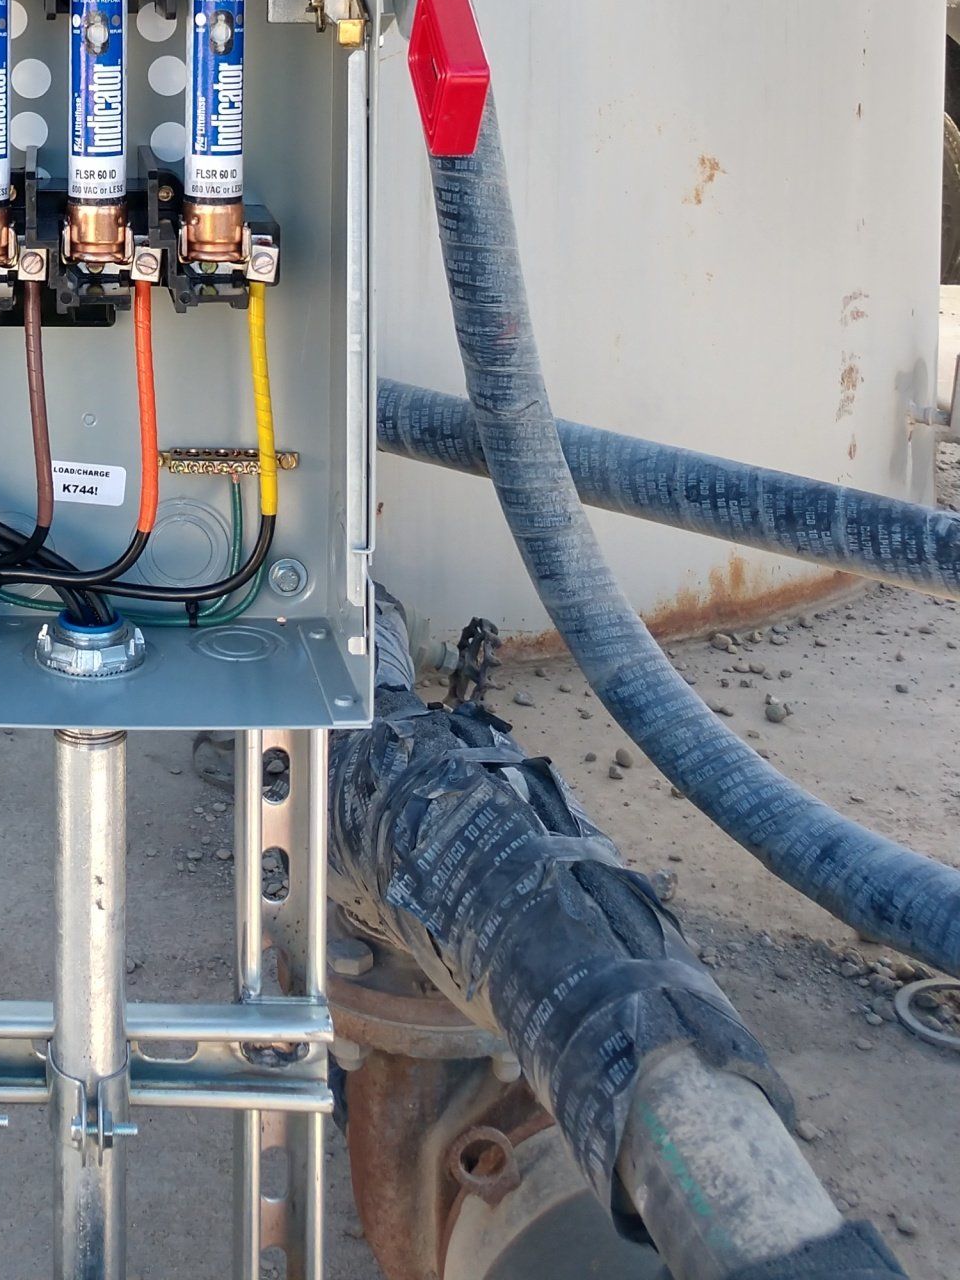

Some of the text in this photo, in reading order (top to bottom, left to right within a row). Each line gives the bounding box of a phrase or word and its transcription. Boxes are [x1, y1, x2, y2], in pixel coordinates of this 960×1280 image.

[75, 97, 83, 138] Littelfuse
[87, 63, 121, 153] Indicator
[197, 96, 206, 134] Littelfuse
[211, 62, 242, 152] Indicator
[75, 169, 116, 180] FLSR 60 ID
[84, 186, 98, 194] VAC
[109, 184, 123, 193] LESS
[196, 169, 237, 179] FLSR 60 ID
[206, 185, 220, 194] VAC
[223, 186, 230, 194] or
[53, 467, 110, 478] LOAD/CHARGE
[434, 806, 497, 887] CALPICO 10 MIL
[478, 913, 501, 950] 10 MIL
[524, 997, 554, 1049] CALPICO
[553, 982, 569, 1000] 10
[597, 1057, 632, 1097] 10 MIL
